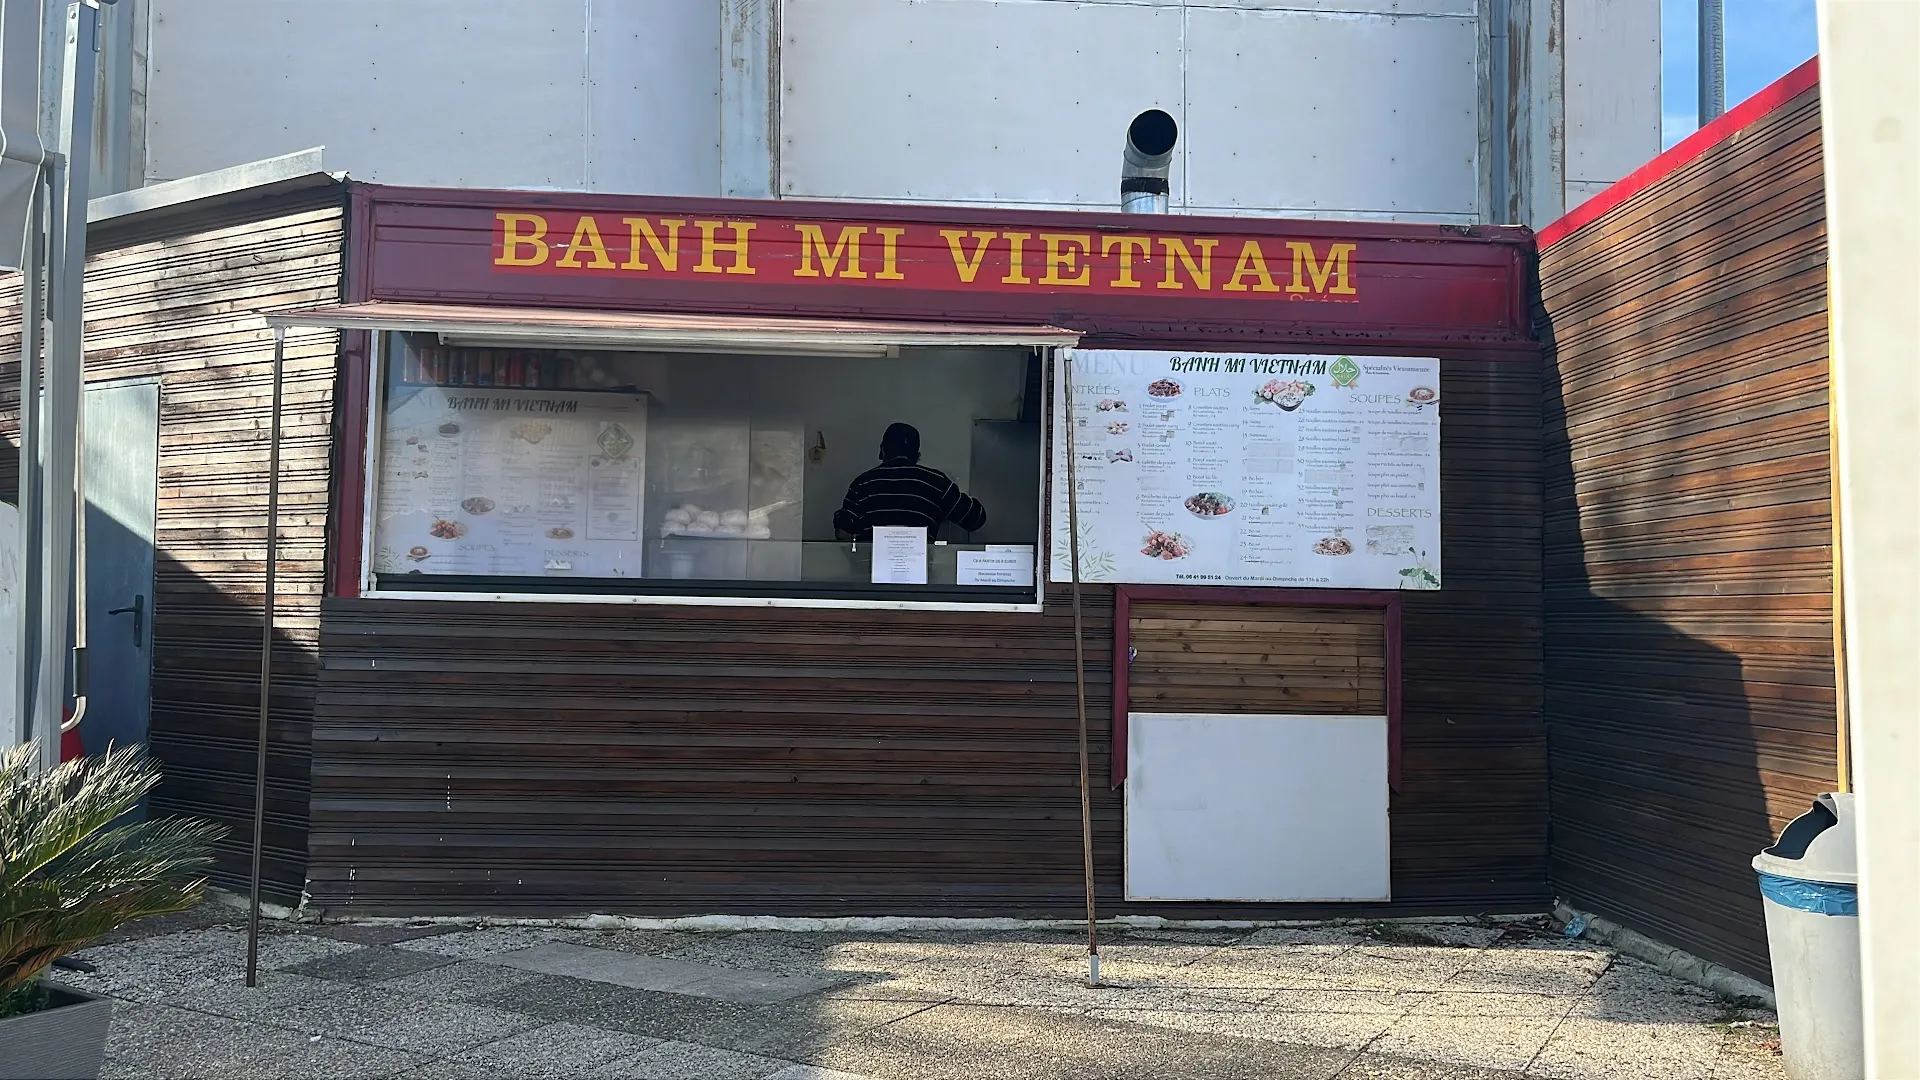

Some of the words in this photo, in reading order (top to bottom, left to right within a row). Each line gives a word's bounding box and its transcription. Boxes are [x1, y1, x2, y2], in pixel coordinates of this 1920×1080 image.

[494, 213, 757, 275] BANH
[793, 224, 905, 280] MI
[939, 230, 1357, 294] VIETNAM
[1071, 351, 1145, 375] MENU
[1169, 356, 1220, 374] BANH
[1224, 358, 1246, 373] MI
[1250, 358, 1327, 376] VIETNAM
[1362, 364, 1392, 374] Spécialités
[1071, 382, 1120, 395] NTRÉES
[1194, 387, 1230, 397] PLATS
[1349, 393, 1401, 404] SOUPES
[513, 398, 579, 414] VIETNAM
[1367, 507, 1432, 519] DESSERTS
